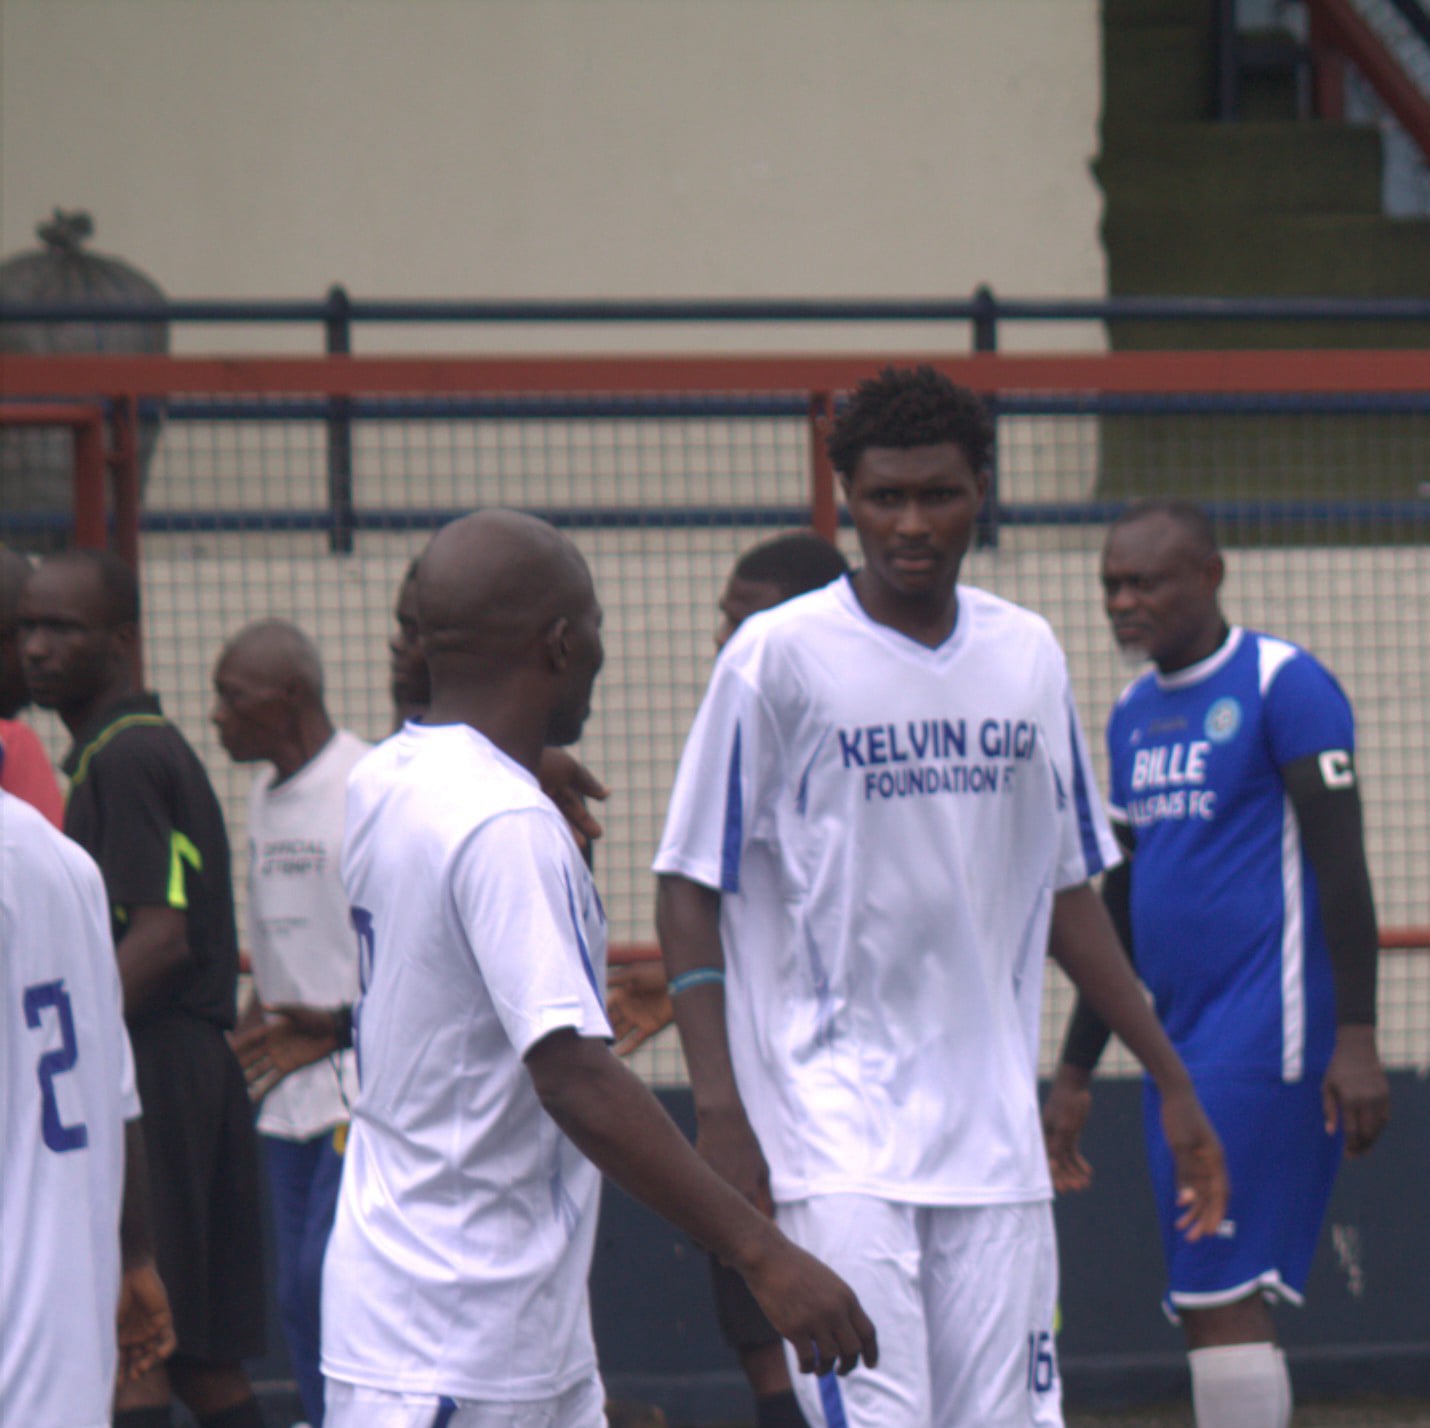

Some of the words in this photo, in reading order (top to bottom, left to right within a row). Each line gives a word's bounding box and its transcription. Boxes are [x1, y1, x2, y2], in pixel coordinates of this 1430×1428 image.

[838, 719, 966, 768] KELVIN
[865, 765, 998, 800] FOUNDATION
[1131, 741, 1211, 792] BILLE
[1318, 750, 1354, 789] C
[1189, 790, 1217, 820] FC
[23, 978, 89, 1153] 2
